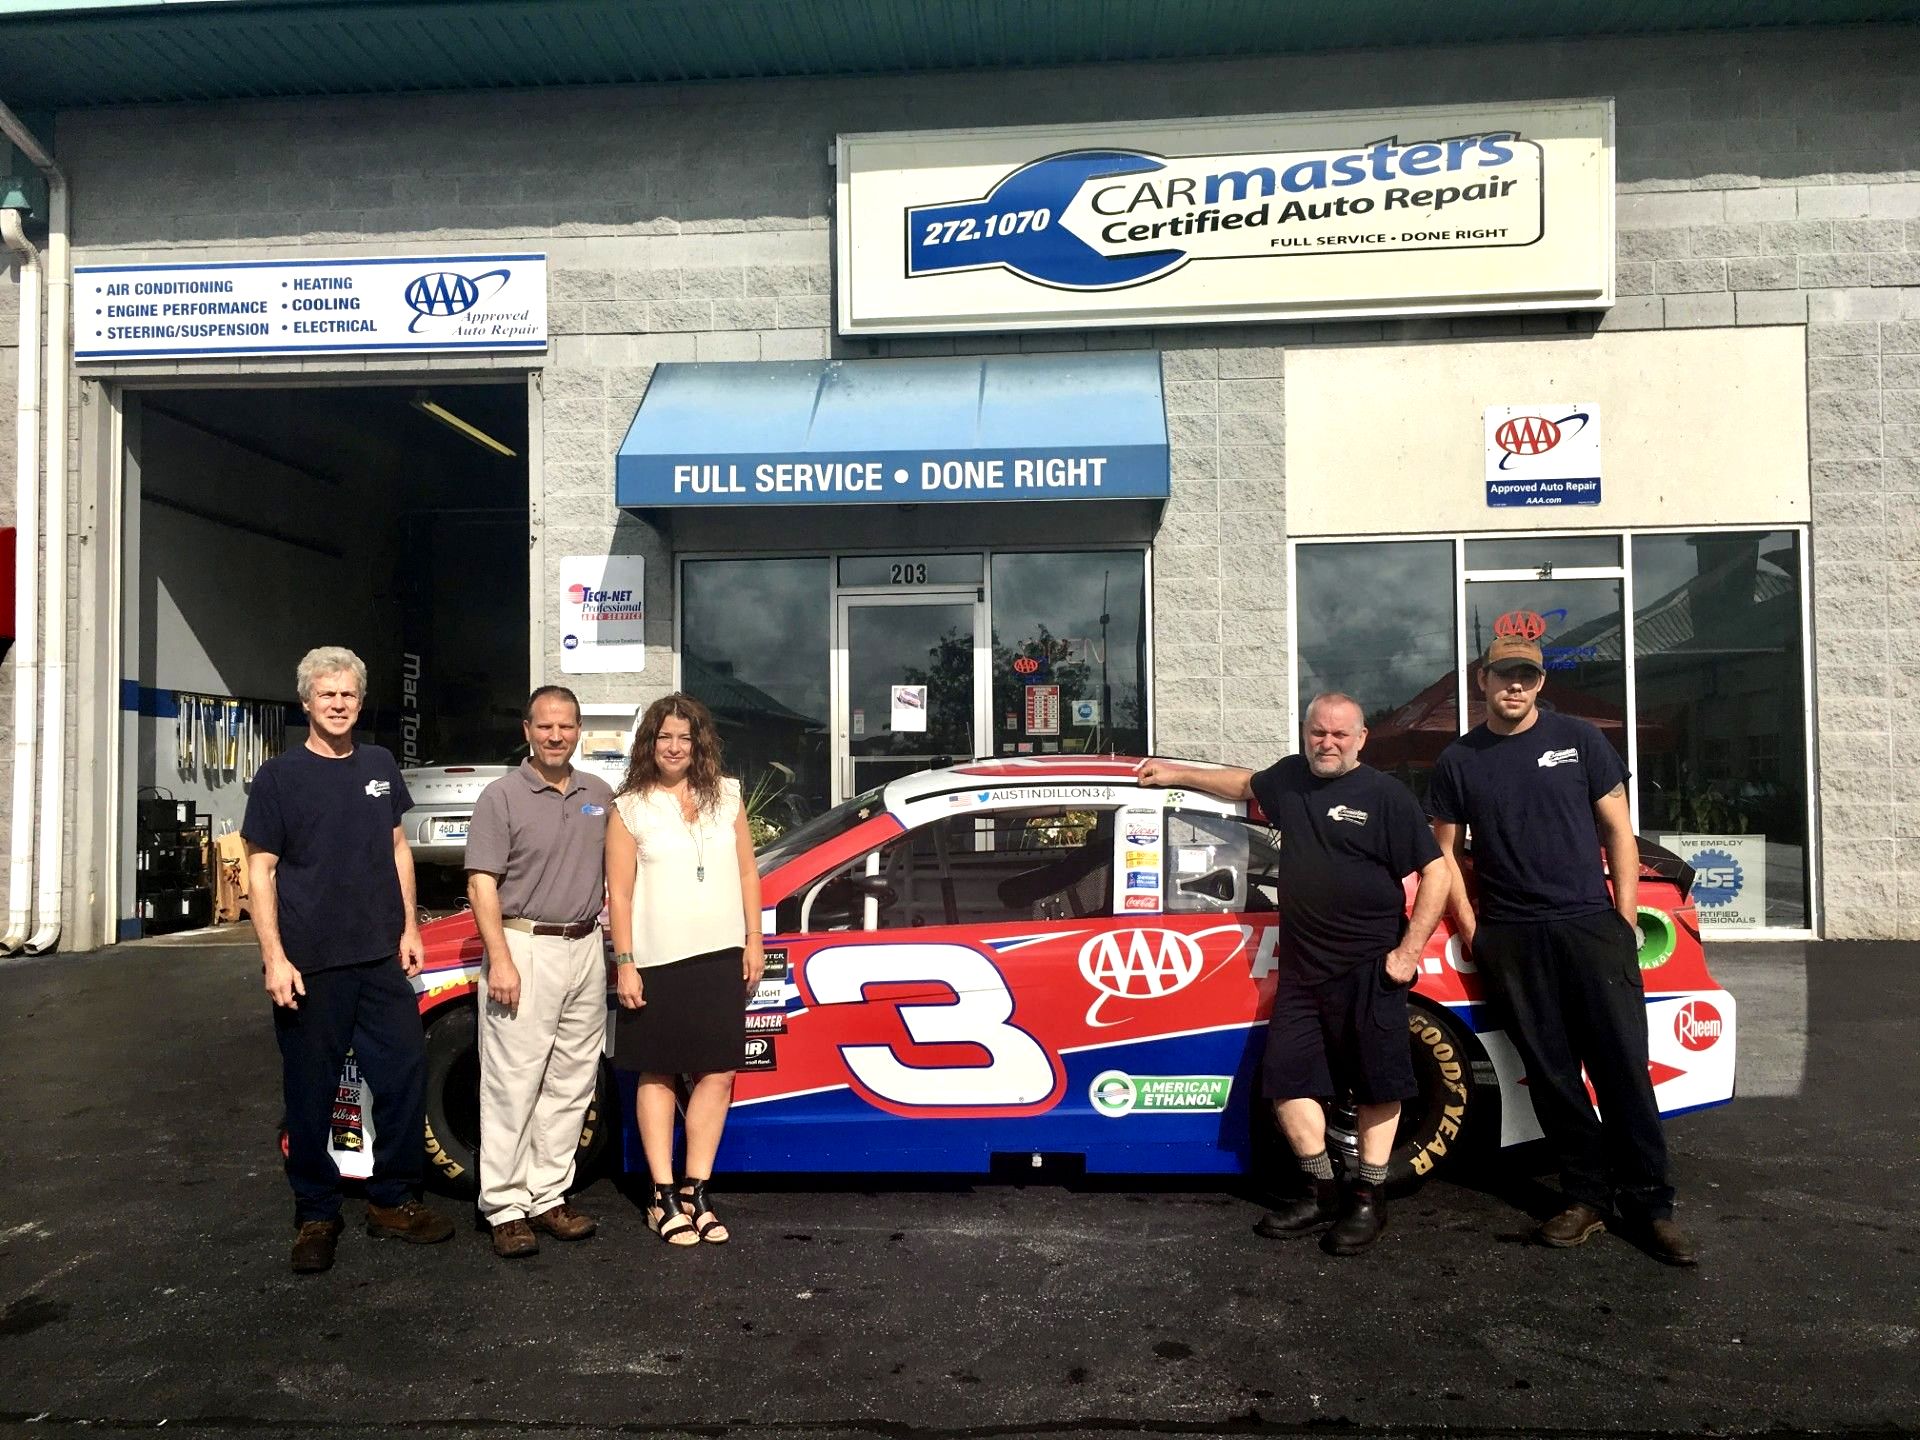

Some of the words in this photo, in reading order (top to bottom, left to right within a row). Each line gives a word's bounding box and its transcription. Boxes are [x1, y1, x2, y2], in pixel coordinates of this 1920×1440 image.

[1101, 203, 1269, 244] Certified
[1278, 197, 1375, 224] Auto
[1384, 175, 1518, 210] Repair
[922, 208, 1050, 246] 272.1070
[1270, 237, 1312, 247] FULL
[1316, 233, 1387, 246] SERVICE
[1401, 231, 1450, 242] DONE
[1455, 228, 1509, 240] RIGHT
[106, 283, 130, 296] AIR
[134, 280, 234, 296] CONDITIONING
[293, 277, 353, 291] HEATING
[408, 272, 475, 316] AAA
[107, 303, 159, 318] ENGINE
[162, 301, 268, 316] PERFORMANCE
[292, 296, 361, 312] COOLING
[462, 310, 529, 324] Approved
[107, 322, 270, 340] STEERING/SUSPENSION
[293, 319, 378, 334] ELECTRICAL
[452, 325, 486, 336] Auto
[490, 324, 539, 337] Repair
[1497, 416, 1559, 454] AAA
[673, 464, 746, 494] FULL
[755, 462, 884, 493] SERVICE
[921, 460, 1004, 490] DONE
[1014, 457, 1108, 488] RIGHT
[1490, 483, 1538, 494] Approved
[1540, 482, 1564, 492] Auto
[1566, 481, 1597, 493] Repair
[1525, 497, 1562, 505] AAA.com
[891, 563, 927, 584] 203
[582, 587, 632, 602] TECH-NET
[582, 601, 642, 613] Professional
[1694, 867, 1735, 888] ASE
[1083, 928, 1199, 998] AAA
[805, 943, 1055, 1104] 3
[1679, 1001, 1721, 1045] Rheem
[1141, 1081, 1222, 1094] AMERICAN
[1408, 1015, 1468, 1176] GOODYEAR
[1143, 1093, 1216, 1106] ETHANOL
[335, 1135, 362, 1145] SUNOC
[424, 1113, 465, 1179] EAGL
